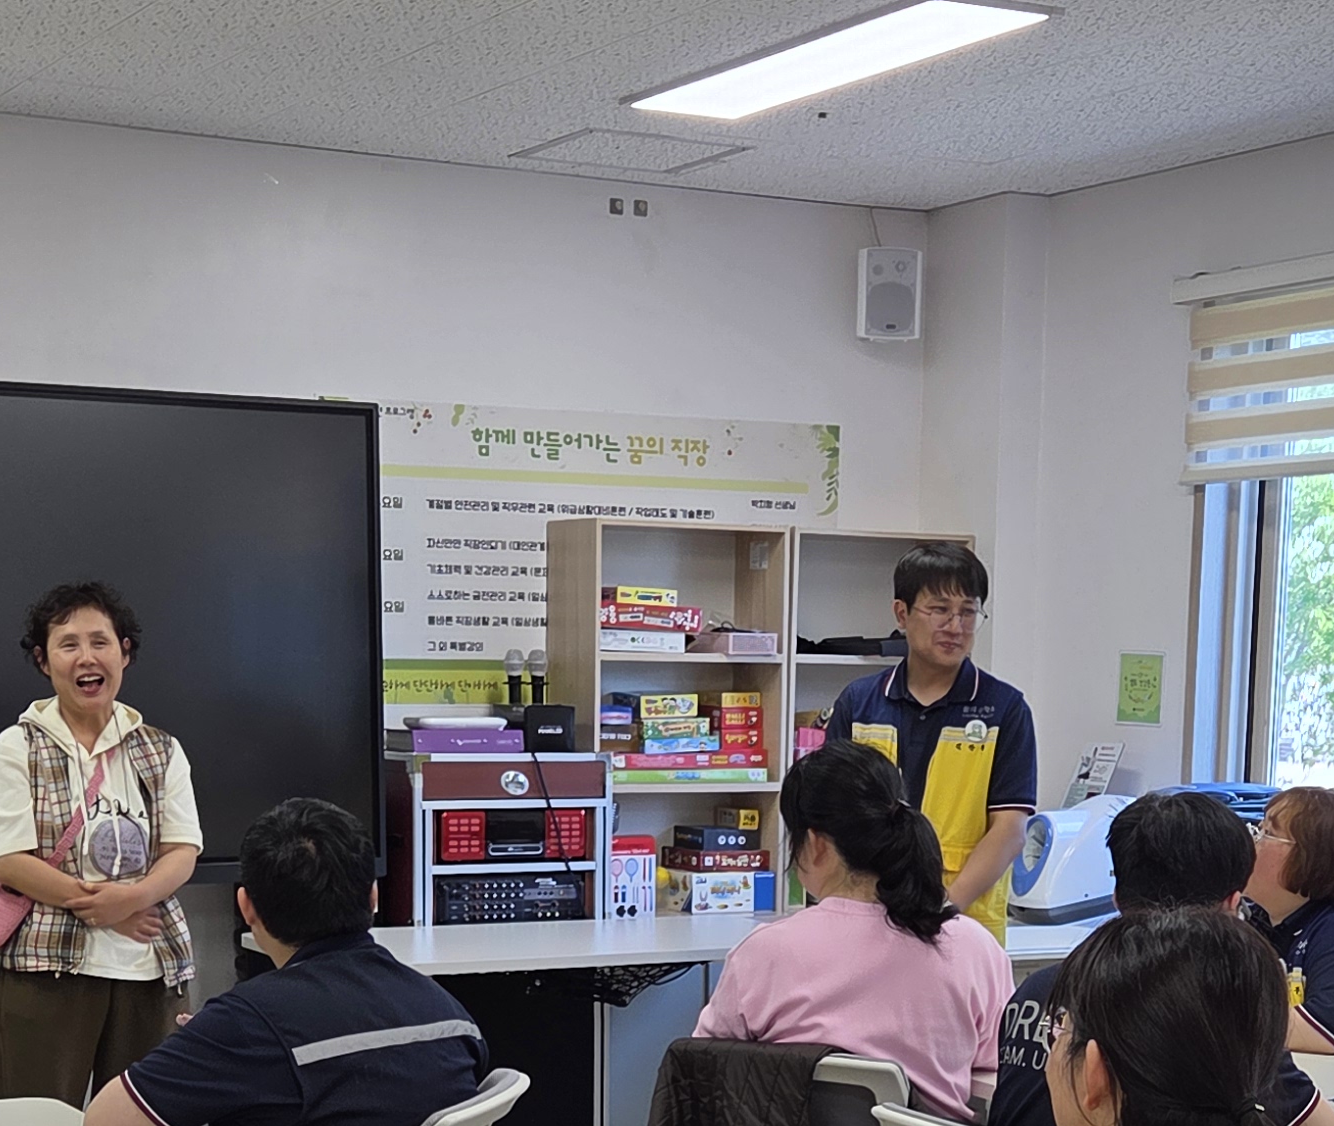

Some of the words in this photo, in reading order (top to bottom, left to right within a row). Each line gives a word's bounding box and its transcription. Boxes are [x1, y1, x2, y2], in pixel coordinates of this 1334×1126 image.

[471, 427, 516, 457] 함께
[523, 430, 621, 464] 만들어가는
[626, 435, 664, 465] 꿈의
[670, 437, 710, 467] 직장
[454, 499, 490, 512] 안전관리
[538, 502, 555, 514] 교육
[475, 565, 509, 576] 건강관리
[511, 566, 528, 577] 교육
[472, 590, 506, 602] 금전관리
[508, 591, 525, 602] 교육
[492, 617, 509, 627] 교육
[427, 641, 436, 652] 그
